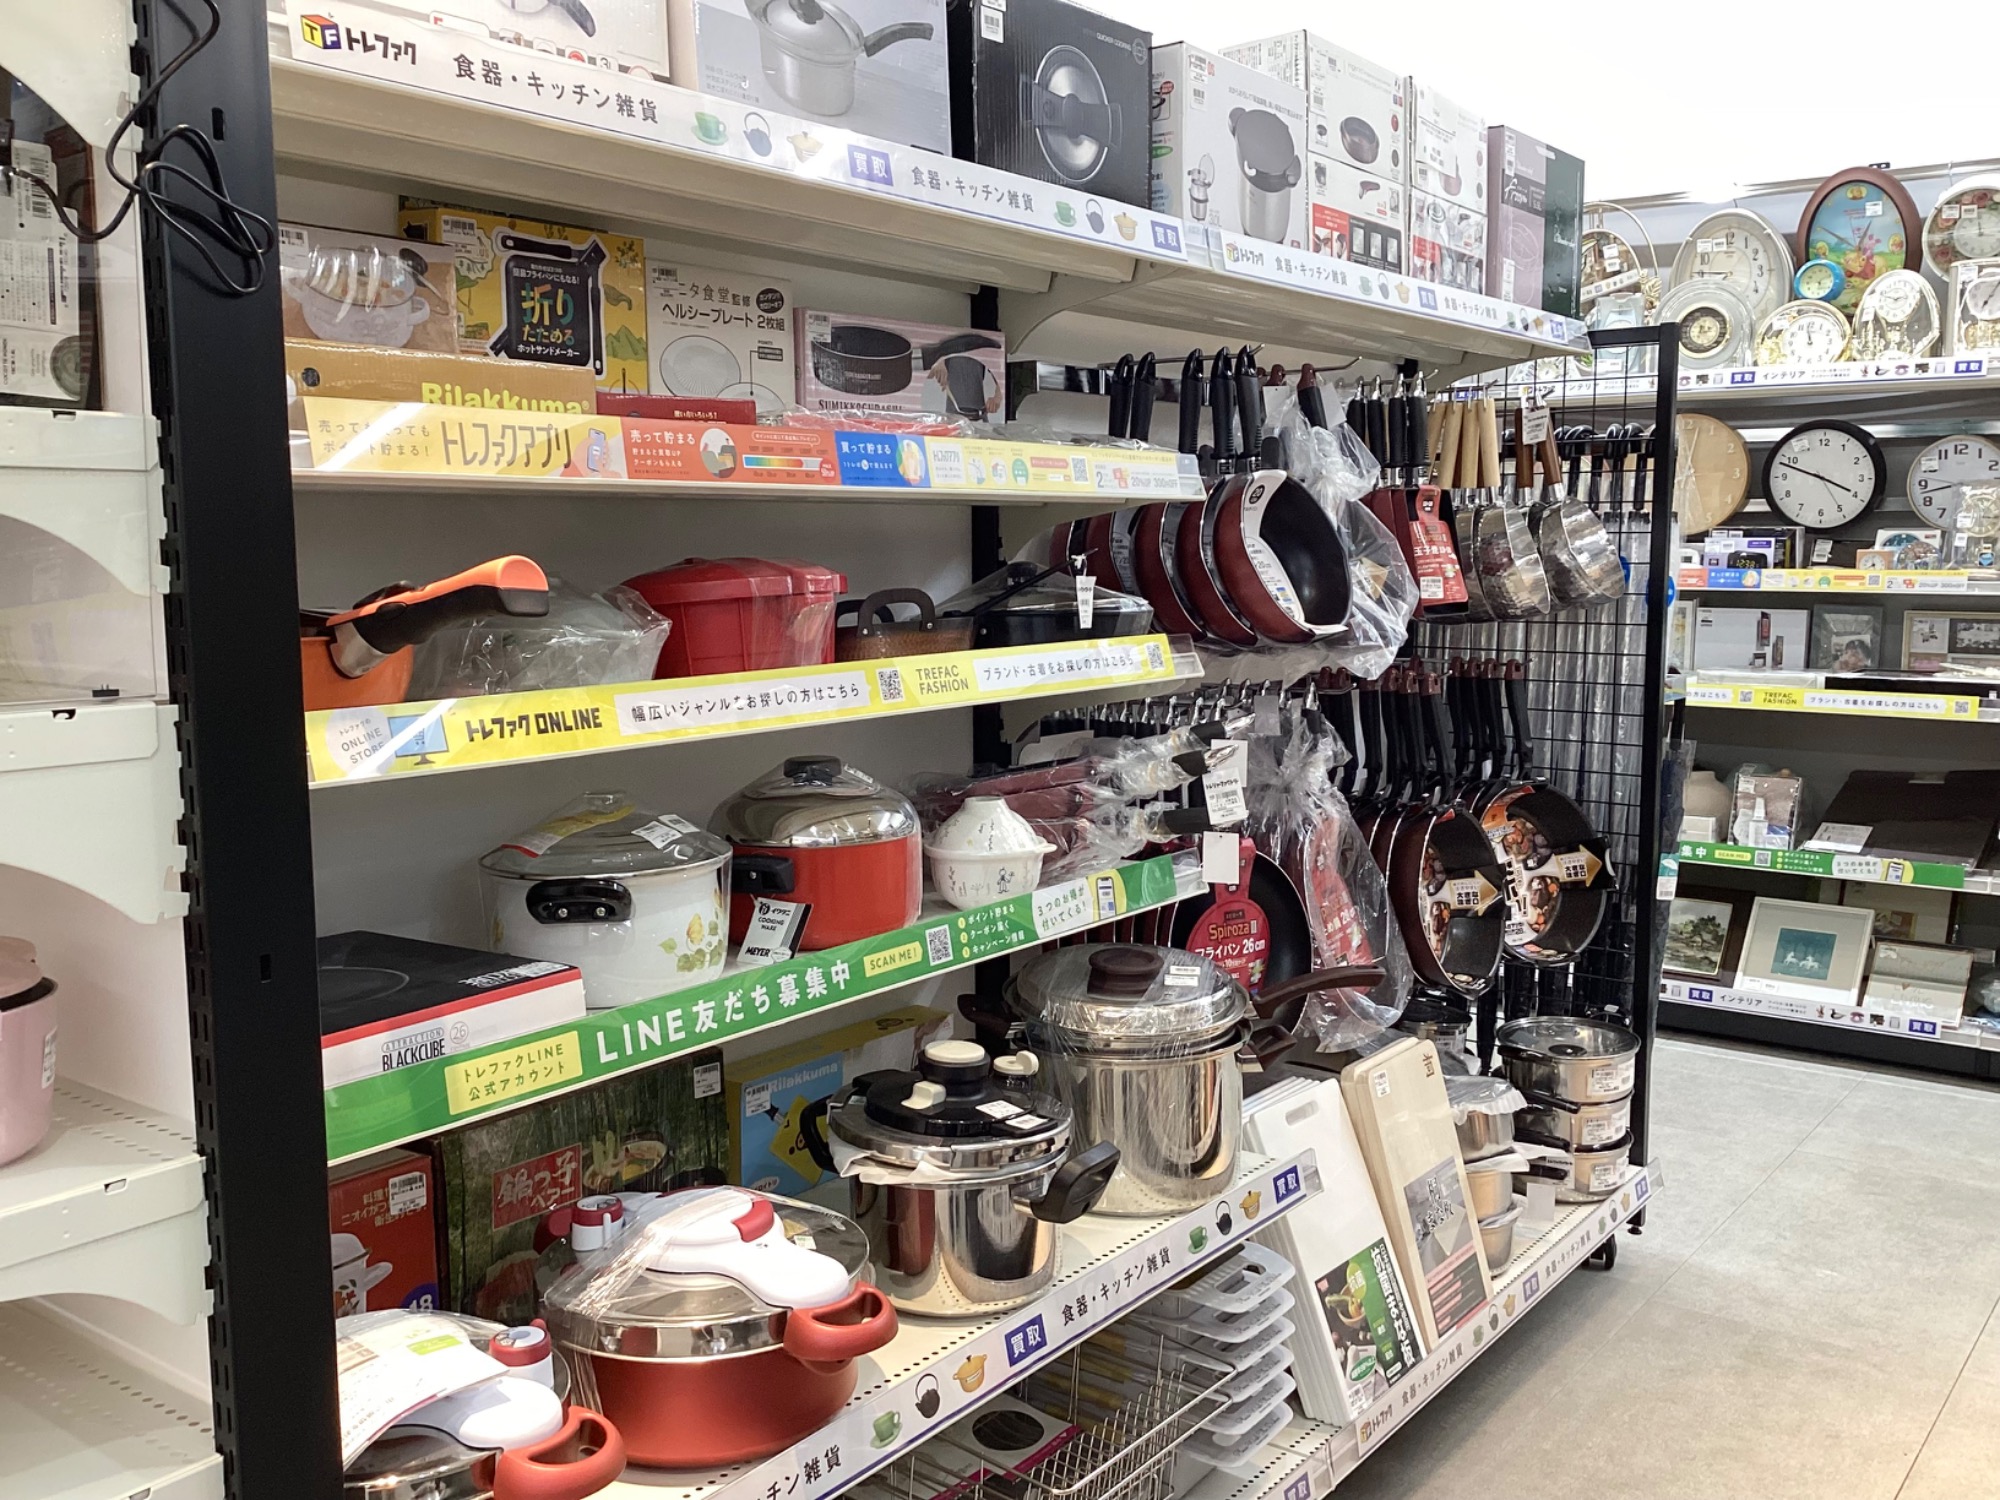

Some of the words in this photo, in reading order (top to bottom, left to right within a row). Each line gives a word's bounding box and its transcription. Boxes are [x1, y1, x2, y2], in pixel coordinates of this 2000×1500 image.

[346, 32, 417, 65] トレファク
[453, 53, 659, 124] 食器・キッチン雑貨
[853, 150, 889, 180] 買取
[911, 166, 1035, 213] 食器・キッチン雑貨
[1154, 226, 1179, 248] 買取
[1275, 256, 1348, 287] 食器・キッチン雑貨
[521, 282, 574, 326] 折り
[662, 303, 754, 328] ヘルシープレート
[522, 325, 575, 347] たためる
[757, 315, 785, 332] 2枚組
[517, 344, 581, 358] ホットサンドメーカー
[1732, 371, 1754, 384] 買取
[1762, 370, 1806, 382] インテリア
[1955, 360, 1983, 373] 買取
[421, 382, 584, 414] Rilakkuma
[441, 421, 572, 470] トレファクアプリ
[630, 429, 696, 446] 売って貯まる
[841, 441, 892, 455] 買って貯まる
[916, 664, 959, 682] TREFAC
[983, 653, 1135, 682] ブランド・古着をお探しの方はこちら
[919, 677, 969, 696] FASHION
[631, 683, 860, 723] 幅広いジャンルをお探しの方はこちら
[1763, 698, 1798, 706] FASHION
[1810, 696, 1939, 710] ブランド・古着をお探しの方はこちら
[466, 715, 531, 742] トレファク
[535, 707, 603, 736] ONLINE
[341, 727, 384, 752] ONLINE
[1681, 845, 1707, 859] 集中
[1208, 923, 1250, 942] Spiroza
[745, 946, 771, 958] MEYER
[870, 952, 898, 971] SCAN
[1195, 943, 1240, 960] フライパン
[1691, 989, 1712, 1001] 買取
[1720, 993, 1763, 1007] インテリア
[597, 959, 851, 1064] LINE友だち募集中
[384, 1028, 443, 1052] ATTRACTION
[1911, 1021, 1936, 1034] 買取
[382, 1038, 446, 1071] BLACKCUBE
[464, 1042, 565, 1083] トレファクLINE
[468, 1061, 566, 1102] 公式アカウント
[769, 1062, 838, 1093] Rilakkuma
[1276, 1171, 1298, 1197] 買取
[1061, 1246, 1172, 1327] 食器・キッチン雑貨
[1010, 1324, 1043, 1358] 買取
[1402, 1343, 1463, 1406] 食器・キッチン雑貨
[760, 1445, 842, 1500] チン雑貨
